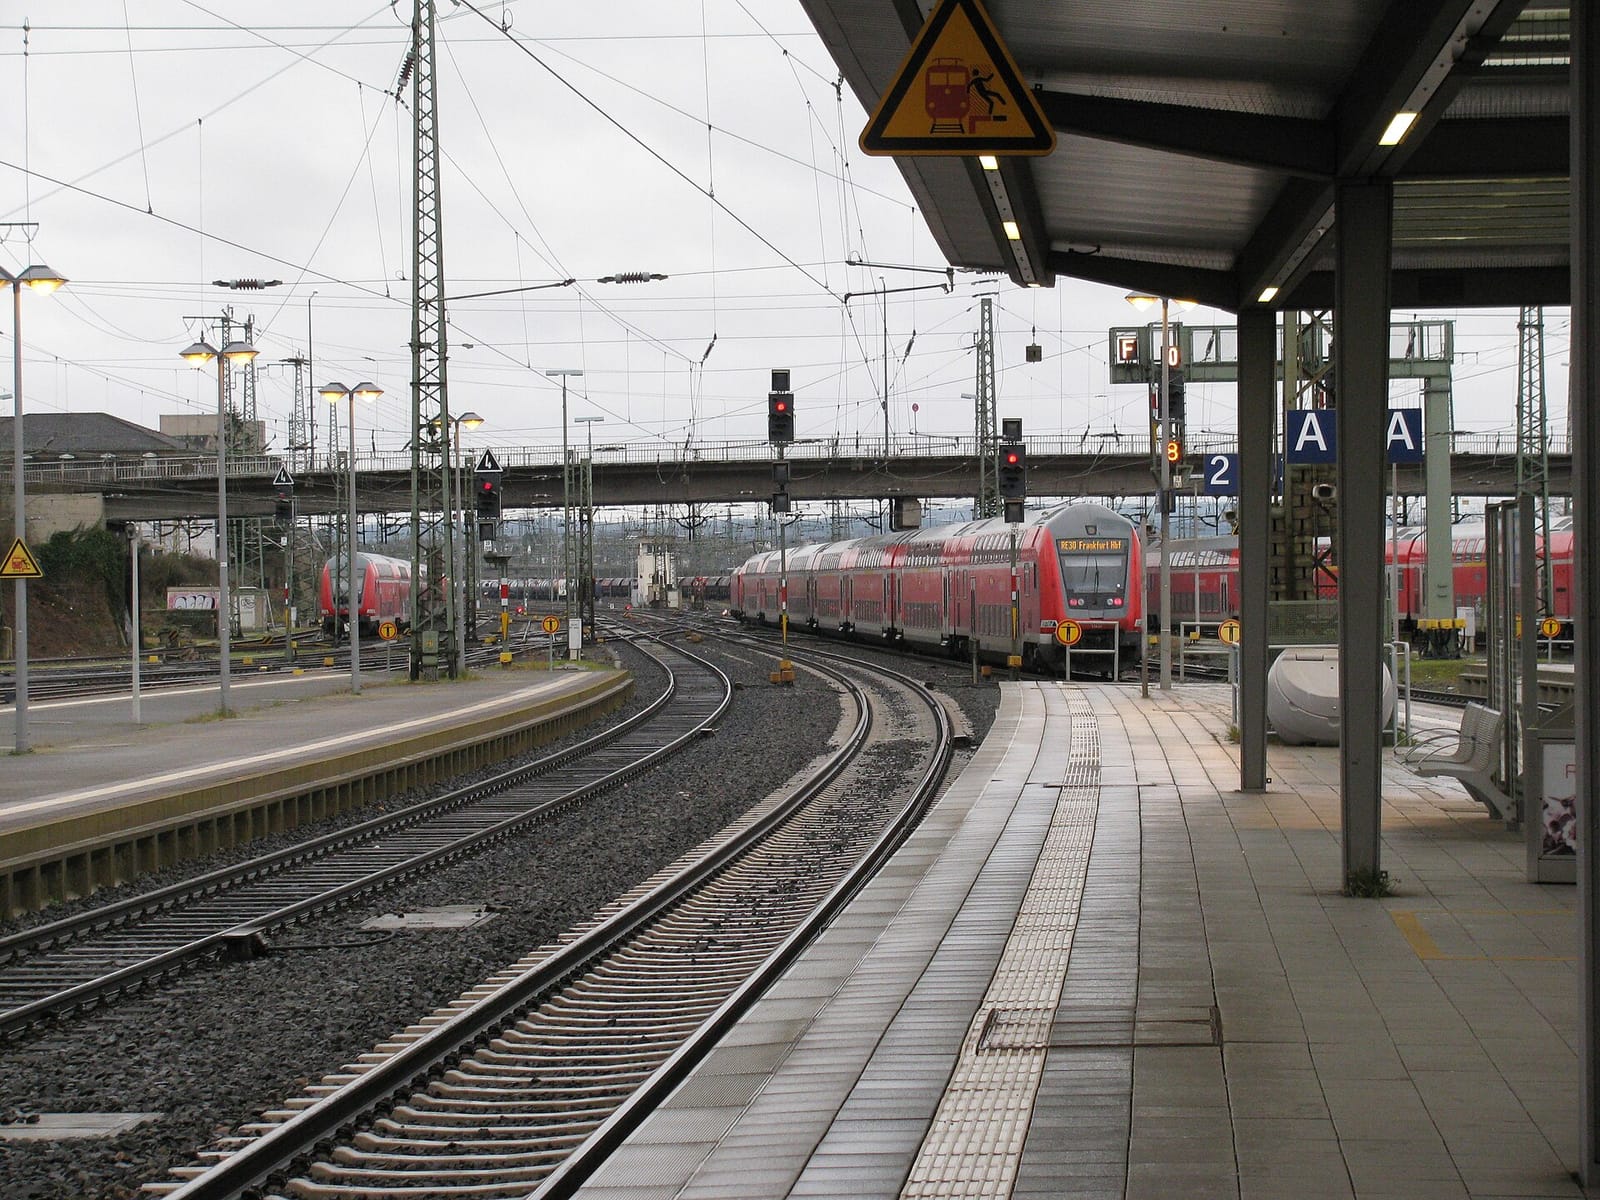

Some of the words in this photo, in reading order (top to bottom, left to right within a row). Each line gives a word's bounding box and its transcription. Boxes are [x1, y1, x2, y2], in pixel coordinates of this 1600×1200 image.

[1121, 339, 1135, 359] F
[1295, 412, 1328, 451] A
[1387, 411, 1415, 450] A
[1210, 455, 1230, 485] 2
[1060, 540, 1077, 550] RE30
[1078, 540, 1109, 550] Frankfurt
[1110, 540, 1122, 550] Hbf
